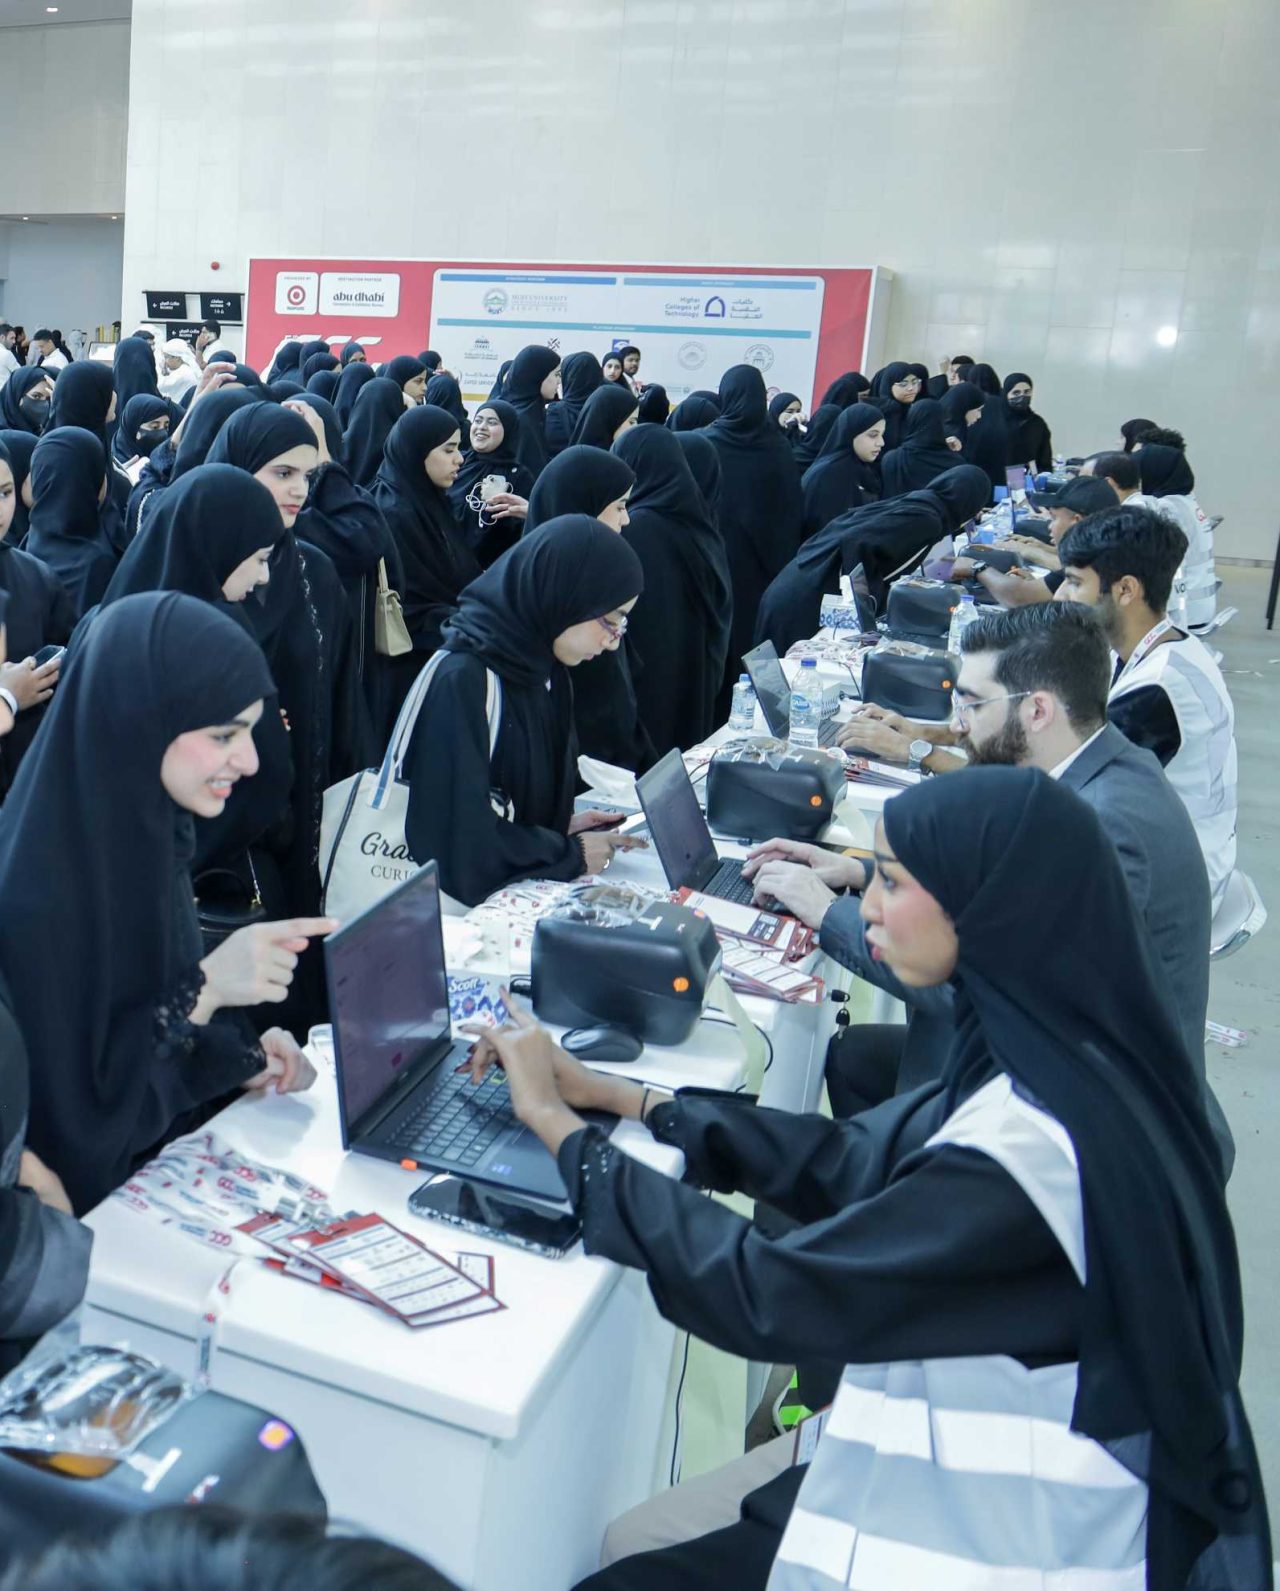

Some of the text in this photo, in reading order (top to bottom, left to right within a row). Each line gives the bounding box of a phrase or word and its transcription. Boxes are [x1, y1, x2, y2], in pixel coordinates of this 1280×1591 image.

[332, 291, 385, 303] abu dhabi
[680, 296, 700, 304] Higher
[665, 303, 692, 311] Colleges
[664, 310, 699, 318] Technology
[1174, 582, 1186, 594] VO
[448, 977, 478, 993] Scott
